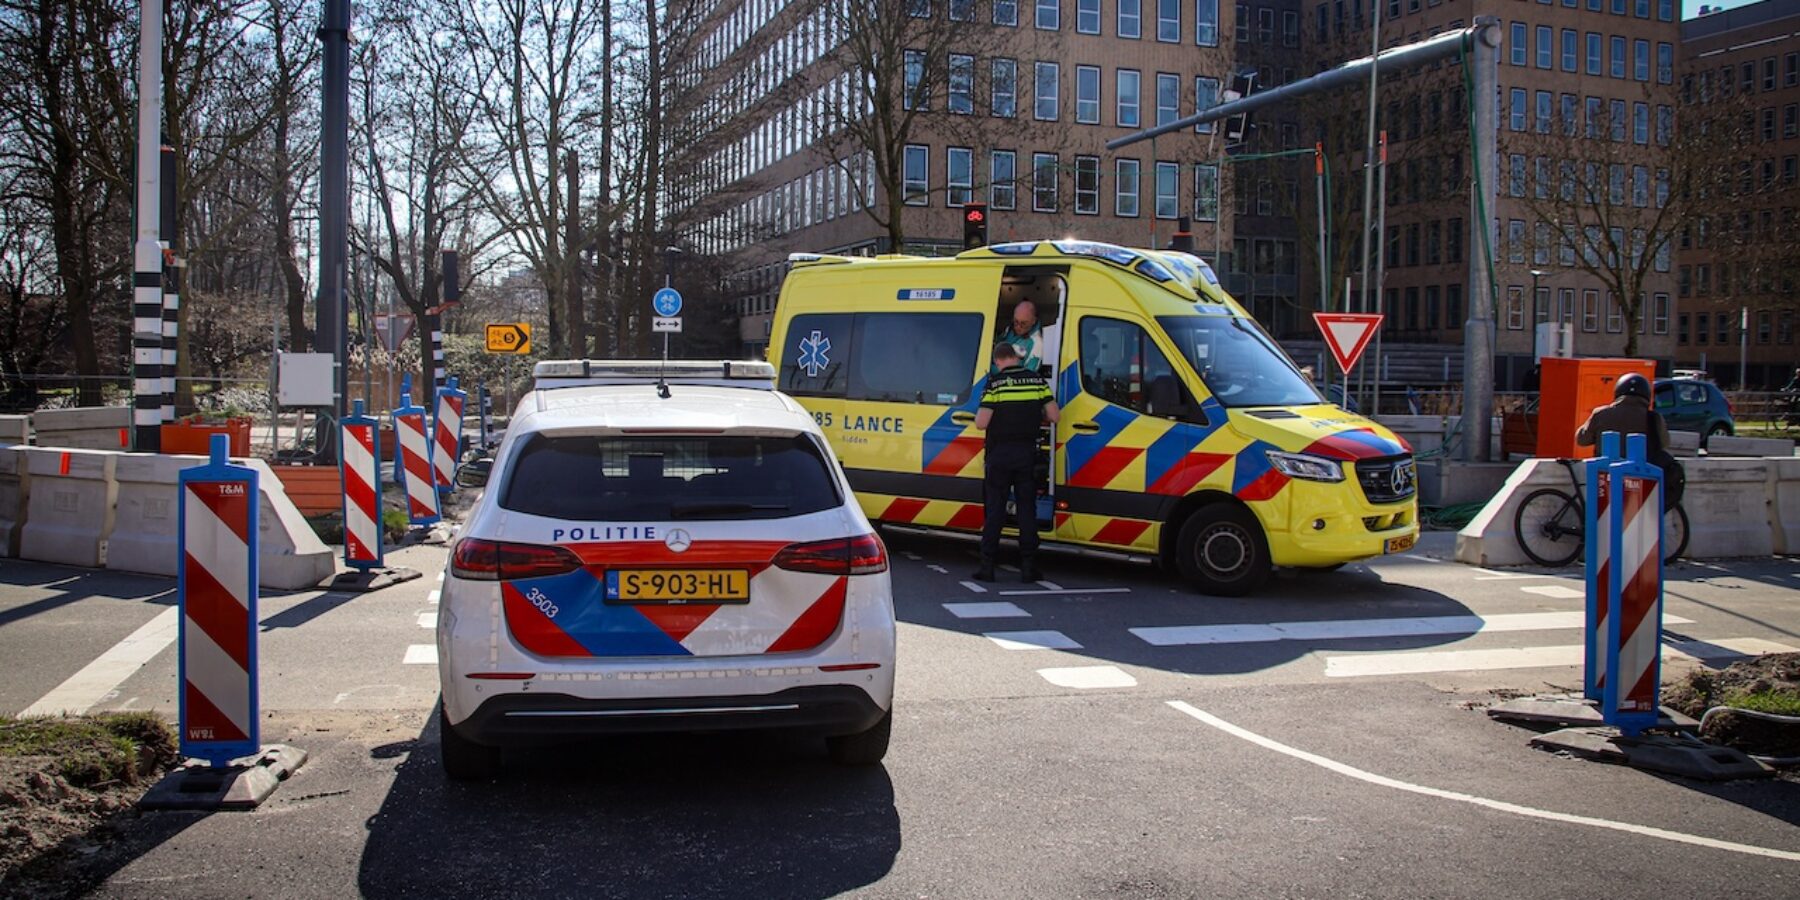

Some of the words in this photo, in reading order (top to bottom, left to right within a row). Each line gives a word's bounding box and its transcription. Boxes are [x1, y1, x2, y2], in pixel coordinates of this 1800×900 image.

[844, 415, 904, 432] LANCE
[219, 484, 244, 495] T&M
[553, 526, 656, 541] POLITIE
[626, 574, 740, 595] S-903-HL
[526, 587, 559, 618] 3503
[189, 729, 215, 739] T&M
